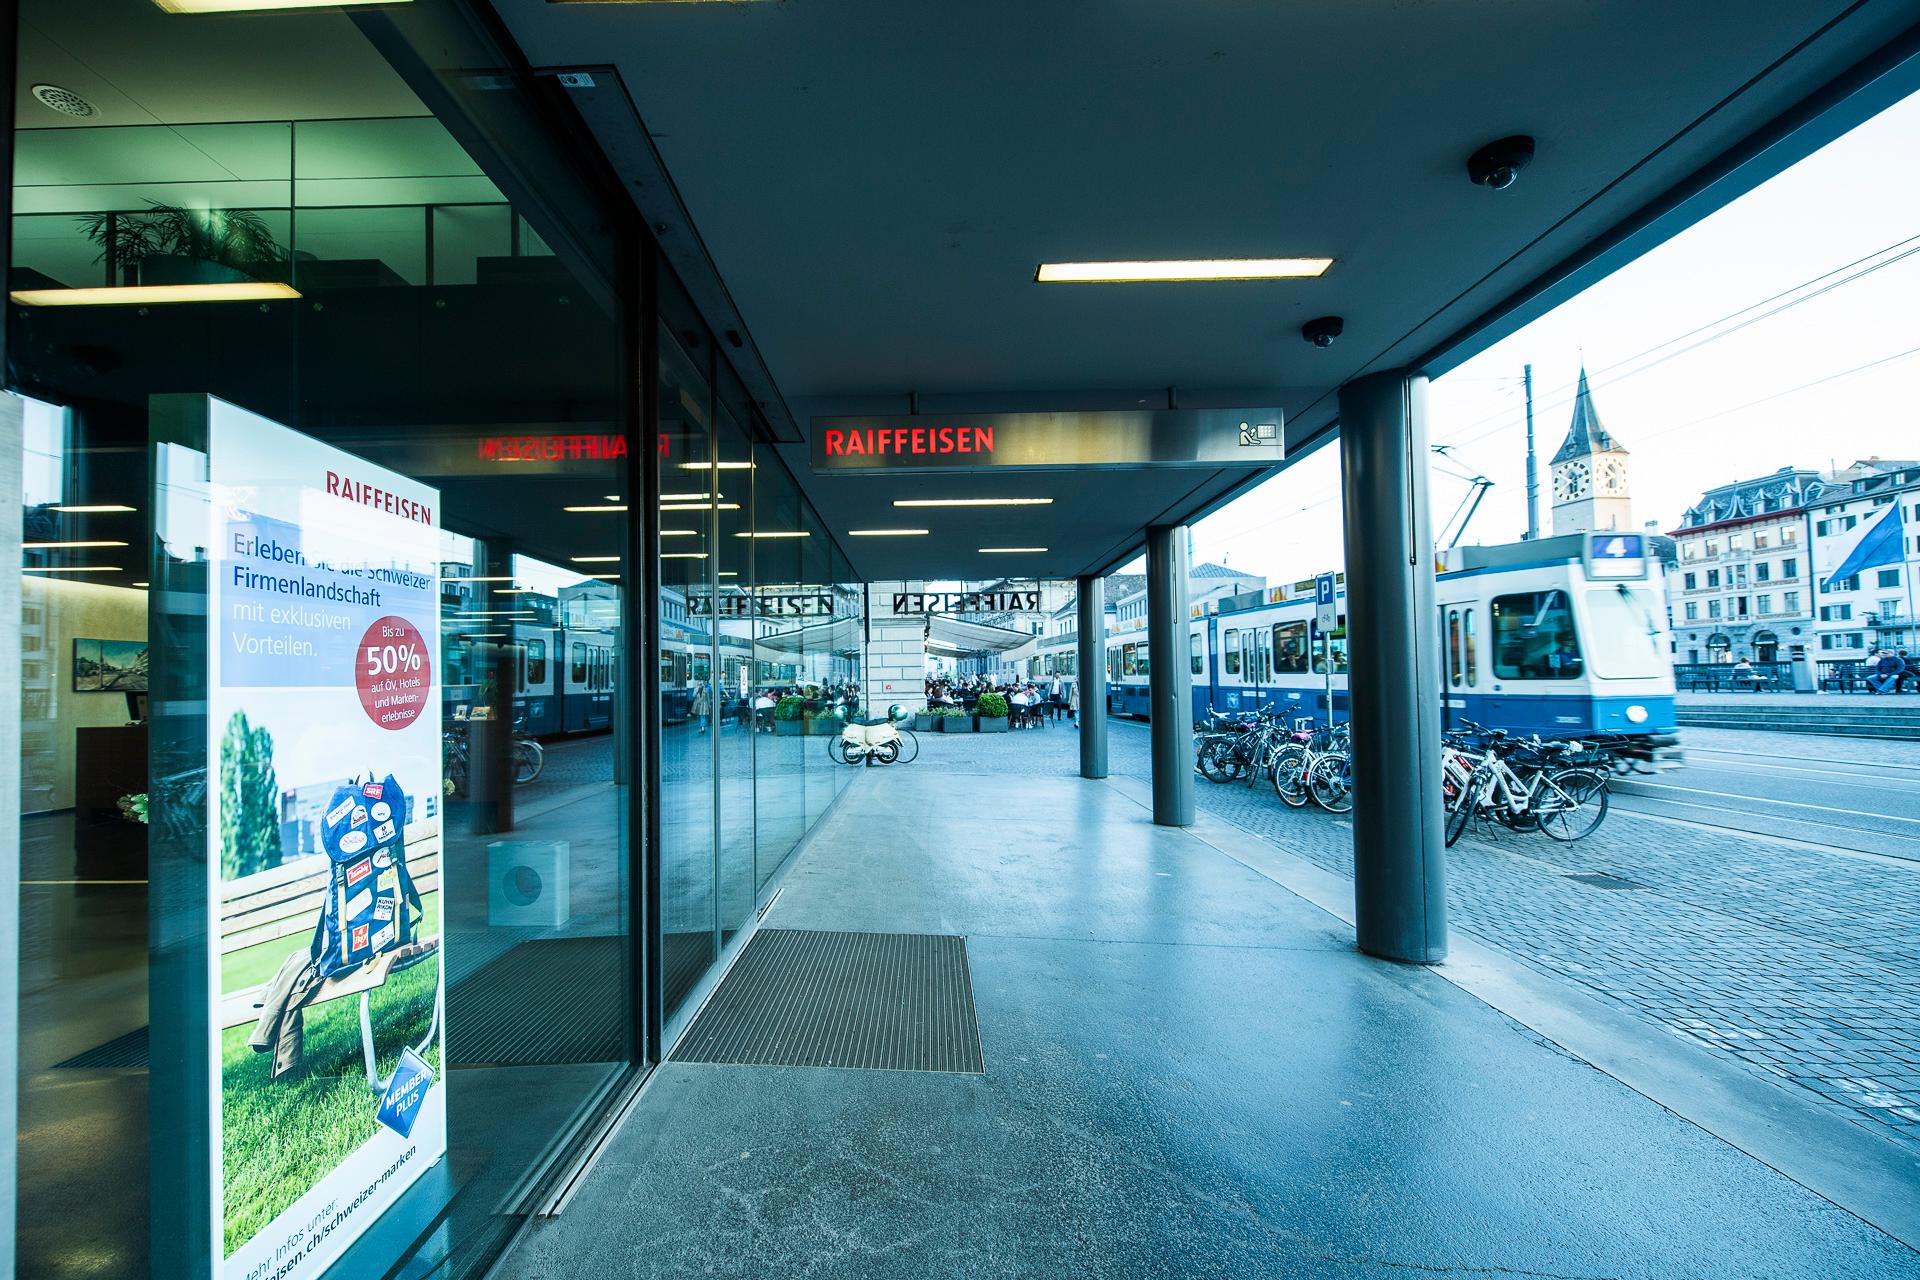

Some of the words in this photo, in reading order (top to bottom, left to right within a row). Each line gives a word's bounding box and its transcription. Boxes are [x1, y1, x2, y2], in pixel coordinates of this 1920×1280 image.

[825, 427, 994, 456] RAIFFEISEN
[326, 470, 431, 526] RAIFFEISEN
[234, 532, 305, 566] Erleben
[1605, 537, 1627, 558] 4
[234, 565, 381, 607] Firmenlandschaft
[1321, 580, 1330, 602] P
[233, 600, 265, 622] mit
[270, 604, 351, 630] exklusiven
[687, 596, 834, 615] RAIFEISEN
[232, 631, 318, 657] Vorteilen.
[382, 626, 394, 638] Bis
[395, 628, 405, 637] zu
[367, 643, 421, 676] 50%
[371, 680, 384, 693] auf
[385, 678, 398, 692] ÖV,
[399, 677, 421, 690] Hotels
[374, 696, 390, 709] und
[391, 692, 420, 706] Marken-
[381, 709, 416, 723] erlebnisse
[386, 1069, 427, 1110] MEMBER
[396, 1089, 420, 1117] PLUS
[276, 1228, 304, 1262] Infos
[307, 1197, 339, 1233] unter:
